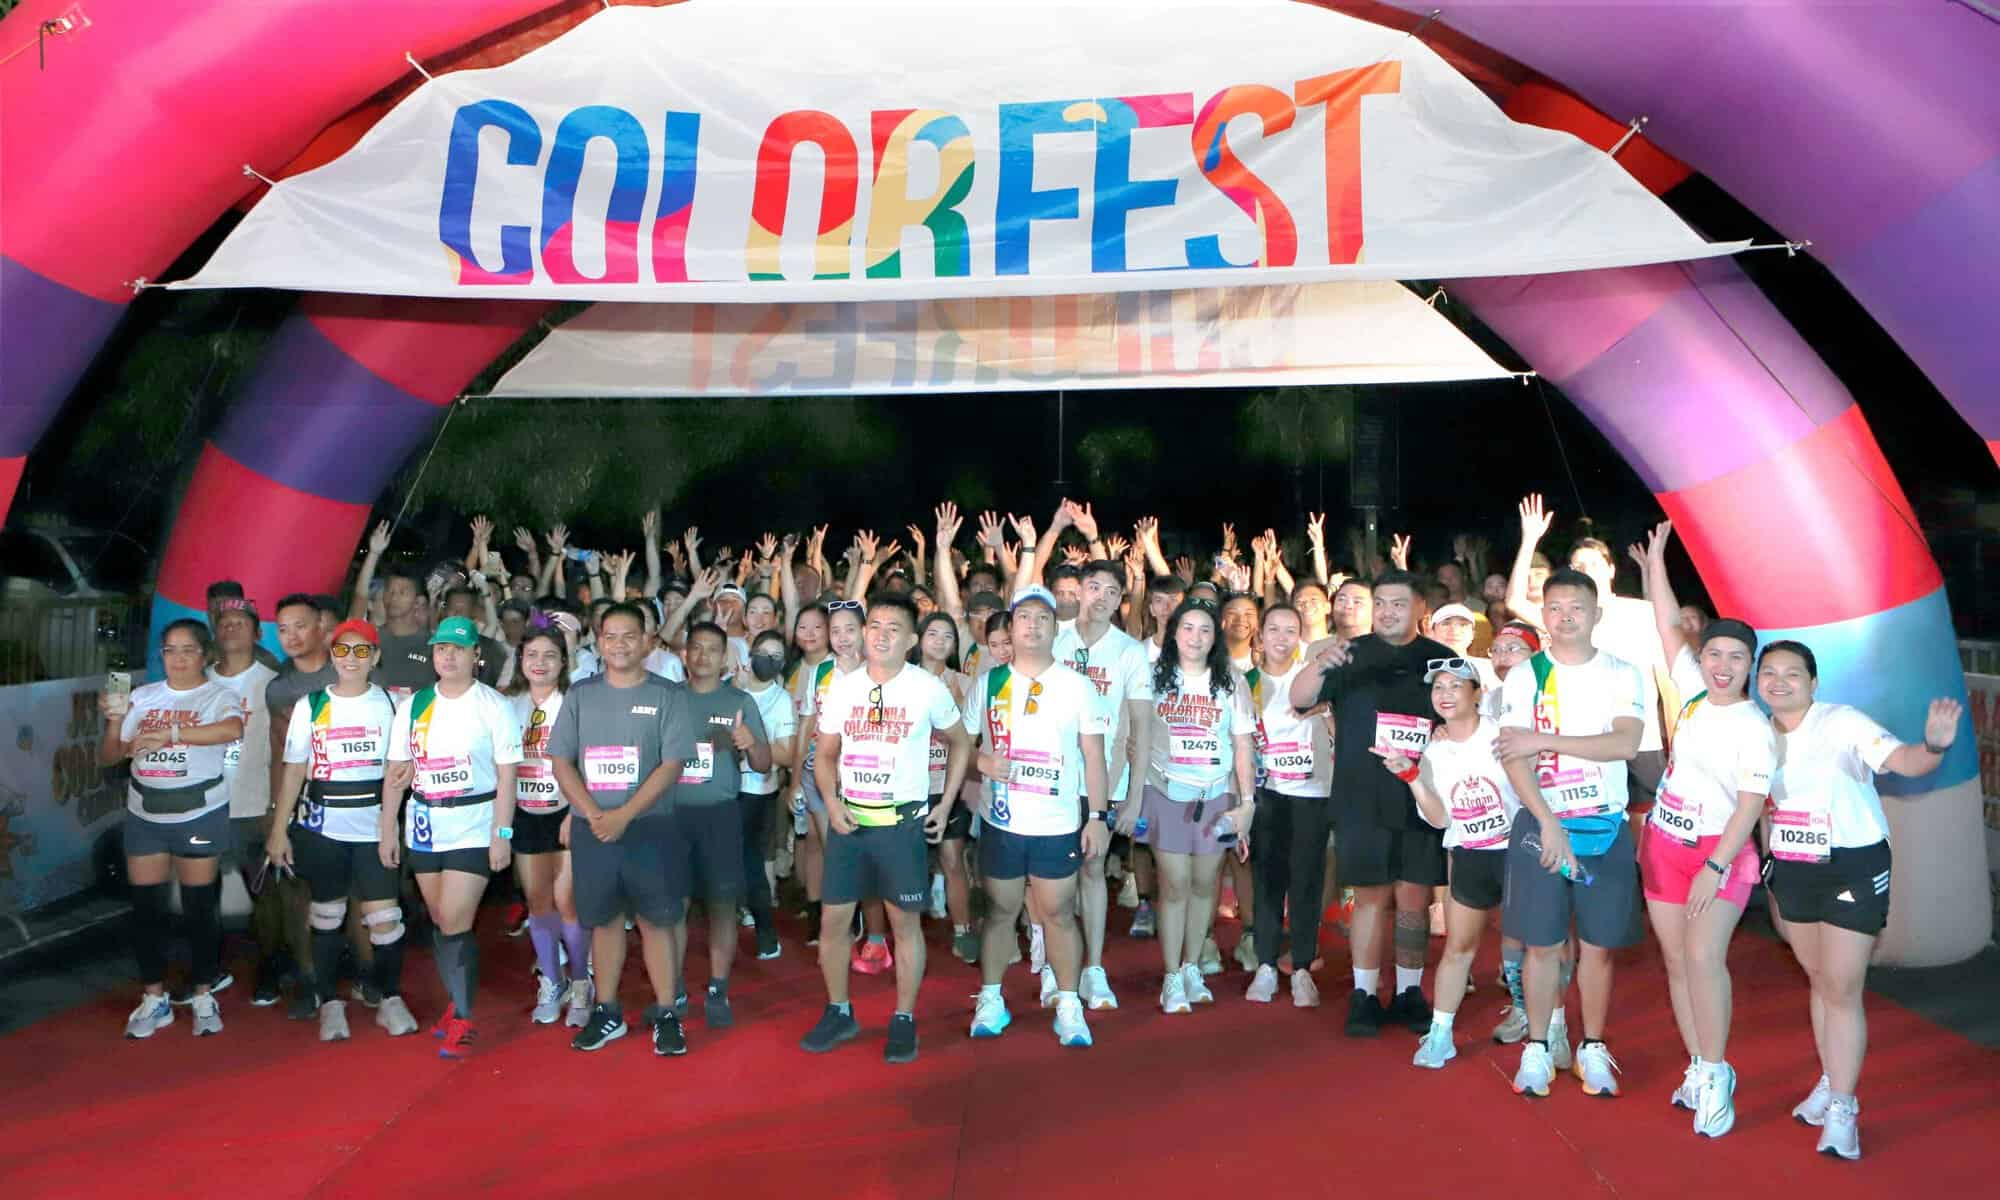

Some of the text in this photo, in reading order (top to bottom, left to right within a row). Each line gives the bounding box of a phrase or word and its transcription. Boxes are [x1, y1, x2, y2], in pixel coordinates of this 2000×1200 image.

[438, 60, 1401, 285] COLORFEST
[631, 705, 658, 716] ARMY
[1157, 702, 1223, 723] COLORFEST
[708, 716, 734, 726] ARMY
[1391, 729, 1427, 744] 12471
[341, 741, 376, 753] 11651
[1182, 740, 1218, 751] 12475
[146, 751, 187, 762] 12045
[929, 749, 947, 758] 501
[1273, 755, 1313, 767] 10304
[597, 763, 636, 775] 11096
[1021, 765, 1060, 780] 10953
[430, 770, 469, 785] 11650
[853, 771, 891, 784] 11047
[520, 781, 555, 792] 11709
[1560, 785, 1599, 801] 11153
[1463, 814, 1506, 834] 10723
[1659, 808, 1694, 831] 11260
[1780, 829, 1828, 846] 10286
